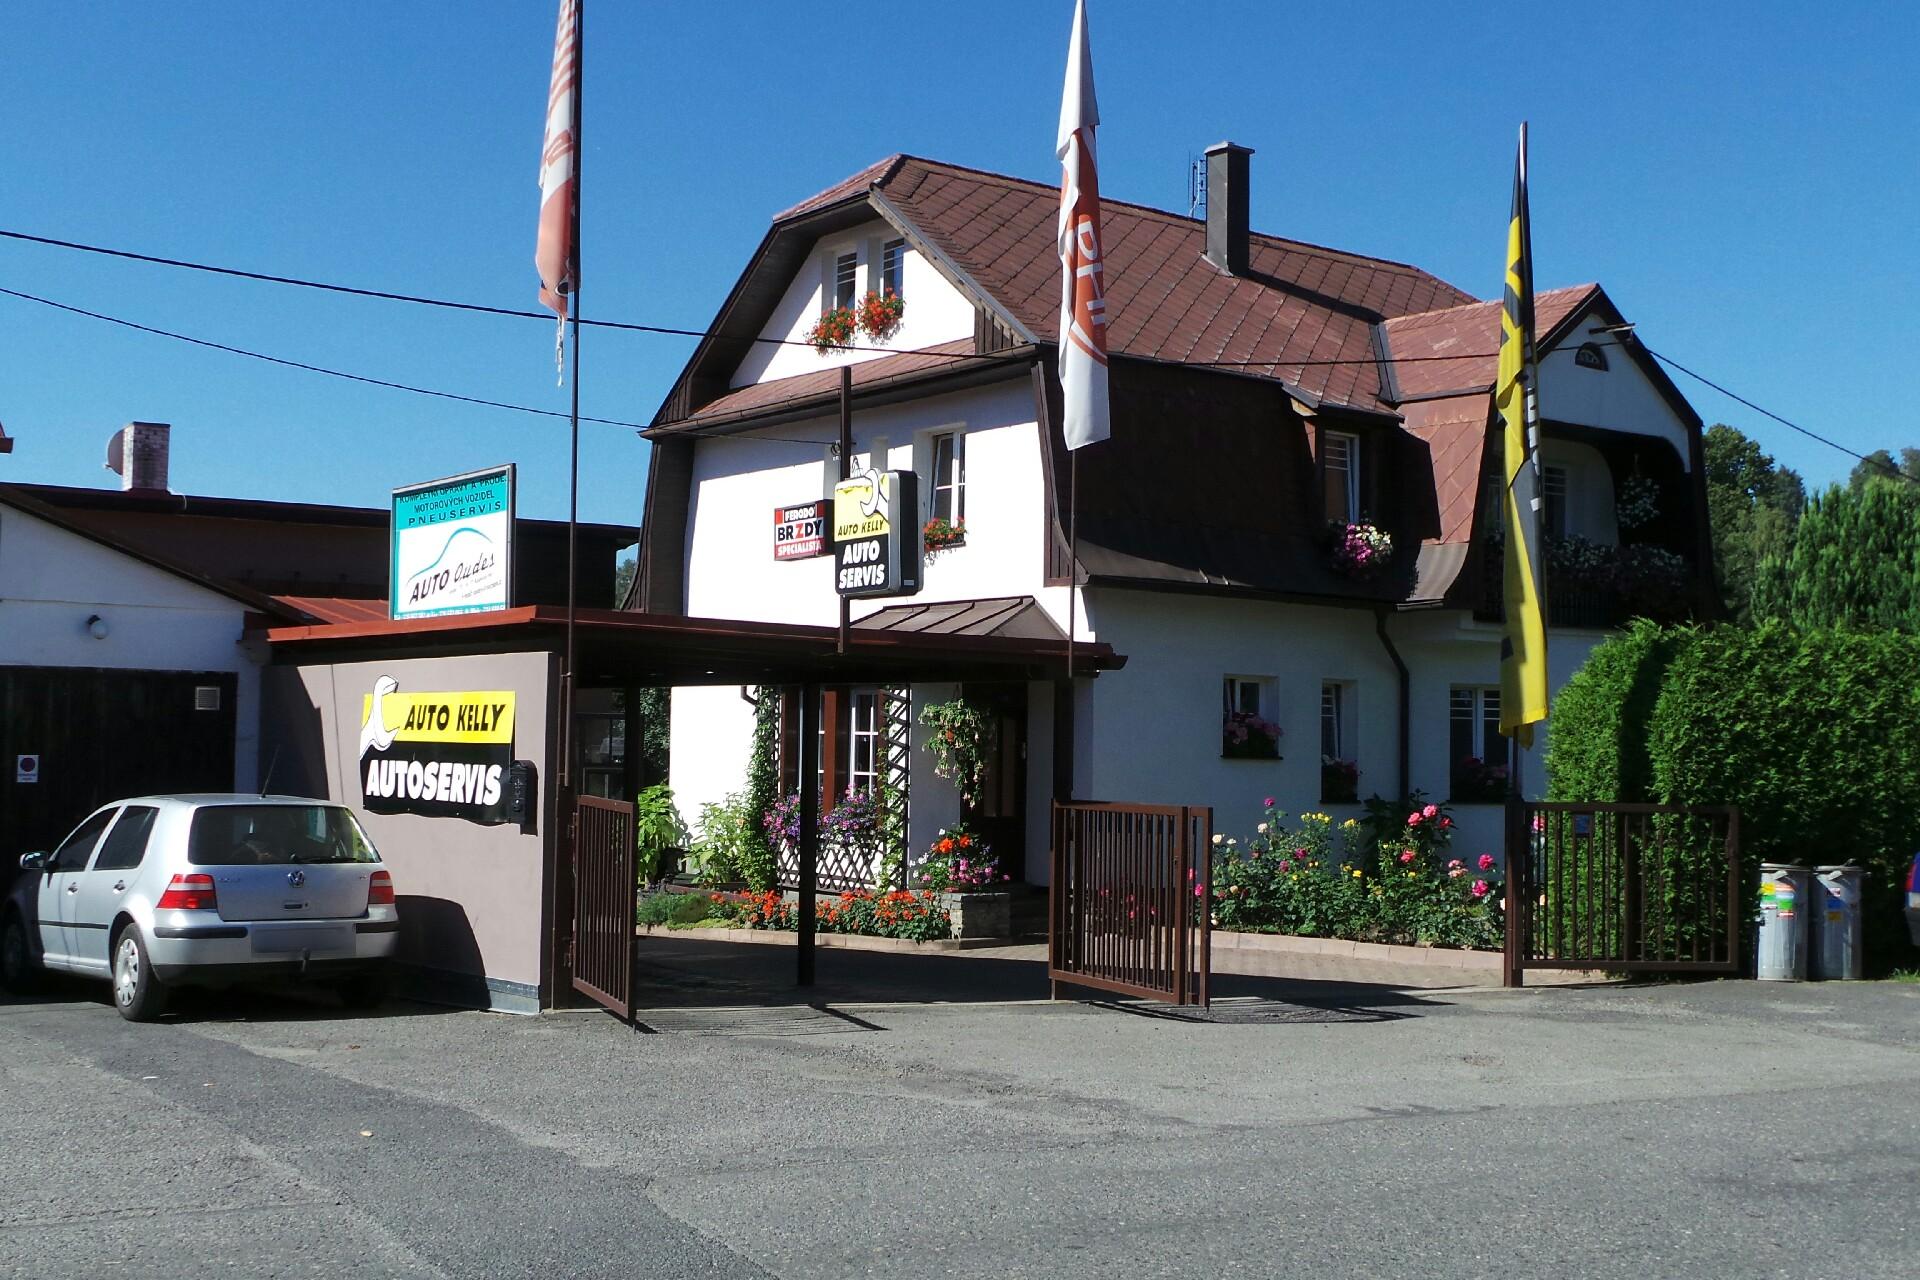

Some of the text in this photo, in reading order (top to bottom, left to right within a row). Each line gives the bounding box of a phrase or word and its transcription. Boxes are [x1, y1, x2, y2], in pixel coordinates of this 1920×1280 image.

[465, 490, 494, 504] VOZIDEL
[408, 501, 501, 526] PNEUSERVIS
[785, 507, 815, 521] FERODO
[777, 519, 823, 541] BRZDY
[837, 519, 884, 537] AUTO KELLY
[842, 540, 880, 565] AUTO
[409, 569, 450, 604] AUTO
[839, 564, 885, 589] SERVIS
[404, 704, 506, 732] AUTO KELLY
[366, 759, 502, 806] AUTOSERVIS
